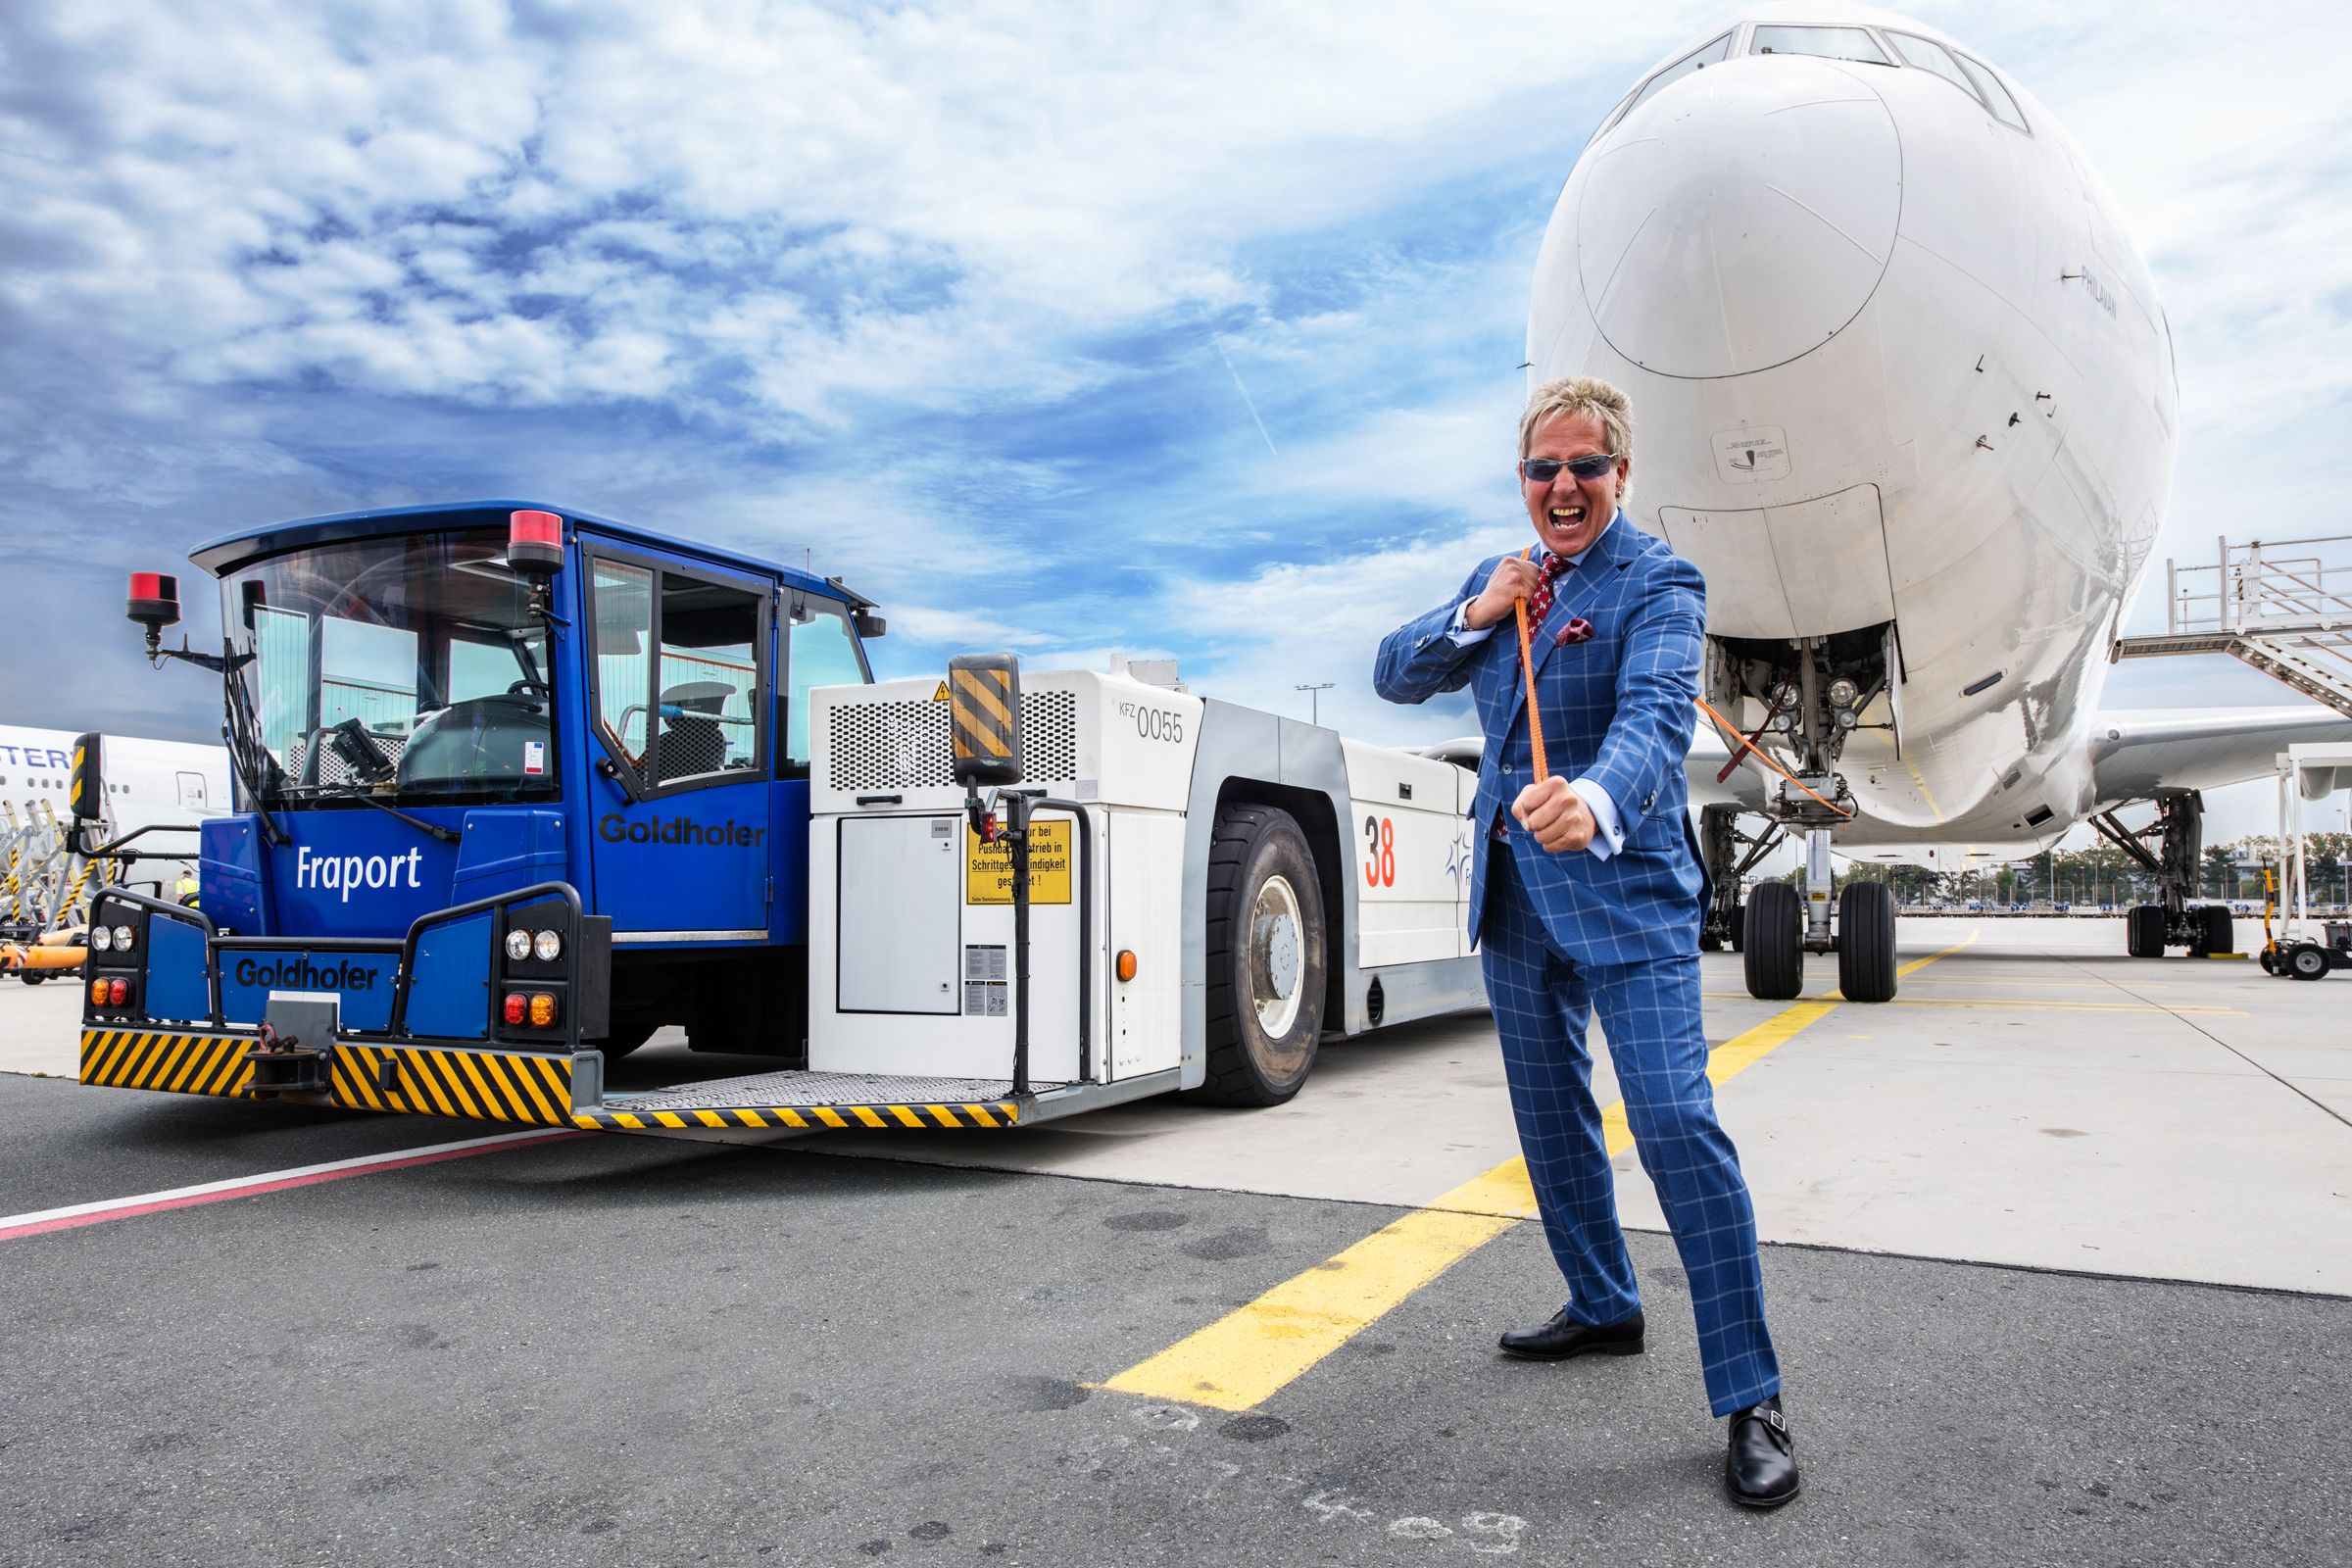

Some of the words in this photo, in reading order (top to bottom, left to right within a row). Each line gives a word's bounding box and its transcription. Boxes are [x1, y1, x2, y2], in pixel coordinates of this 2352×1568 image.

[1119, 702, 1136, 718] KFZ
[1137, 706, 1183, 744] 0055
[599, 813, 766, 847] Goldhofer
[1039, 826, 1052, 837] bei
[1054, 842, 1062, 853] in
[1365, 815, 1396, 888] 38
[297, 846, 422, 903] Fraport
[235, 958, 378, 991] Goldhofer
